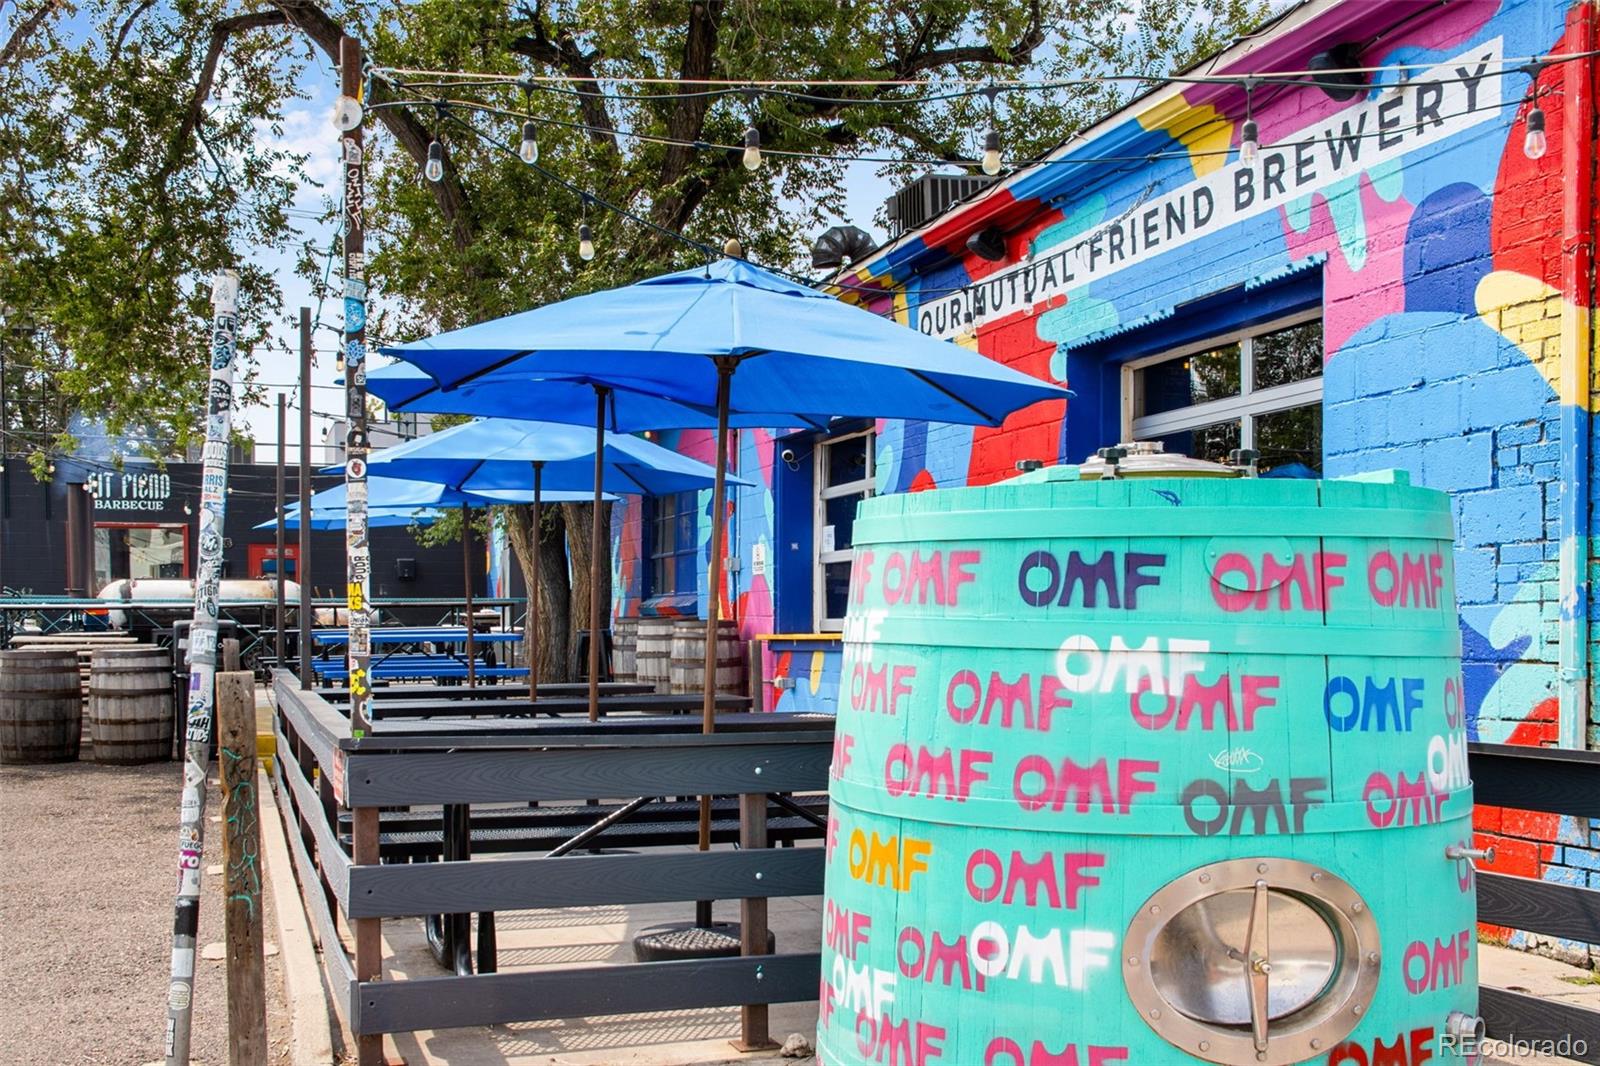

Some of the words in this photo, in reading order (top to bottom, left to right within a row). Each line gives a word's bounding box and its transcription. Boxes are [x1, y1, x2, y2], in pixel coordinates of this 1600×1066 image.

[920, 298, 962, 336] OUR
[971, 252, 1075, 319] MUTUAL
[1089, 185, 1215, 273] FRIEND
[1234, 53, 1494, 211] BREWERY
[94, 500, 164, 511] BARBECUE
[882, 550, 981, 607] OMF
[1017, 549, 1167, 610] OMF
[1209, 552, 1348, 612] OMF
[1367, 550, 1444, 609] OMF
[850, 661, 917, 716] OMF
[1055, 633, 1211, 698] OMF
[945, 668, 1074, 733] OMF
[1129, 672, 1281, 732] OMF
[1323, 675, 1425, 733] OMF
[884, 743, 994, 803] OMF
[1012, 754, 1161, 815] OMF
[1427, 734, 1471, 791] OM
[1183, 777, 1329, 837] OMF
[1362, 770, 1451, 829] OMF
[849, 827, 933, 892] OMF
[965, 848, 1106, 910] OMF
[826, 898, 872, 961] OMF
[970, 920, 1116, 992] OMF
[832, 953, 898, 1022] OMF
[1402, 930, 1470, 996] OMF
[855, 1007, 947, 1066] OMF
